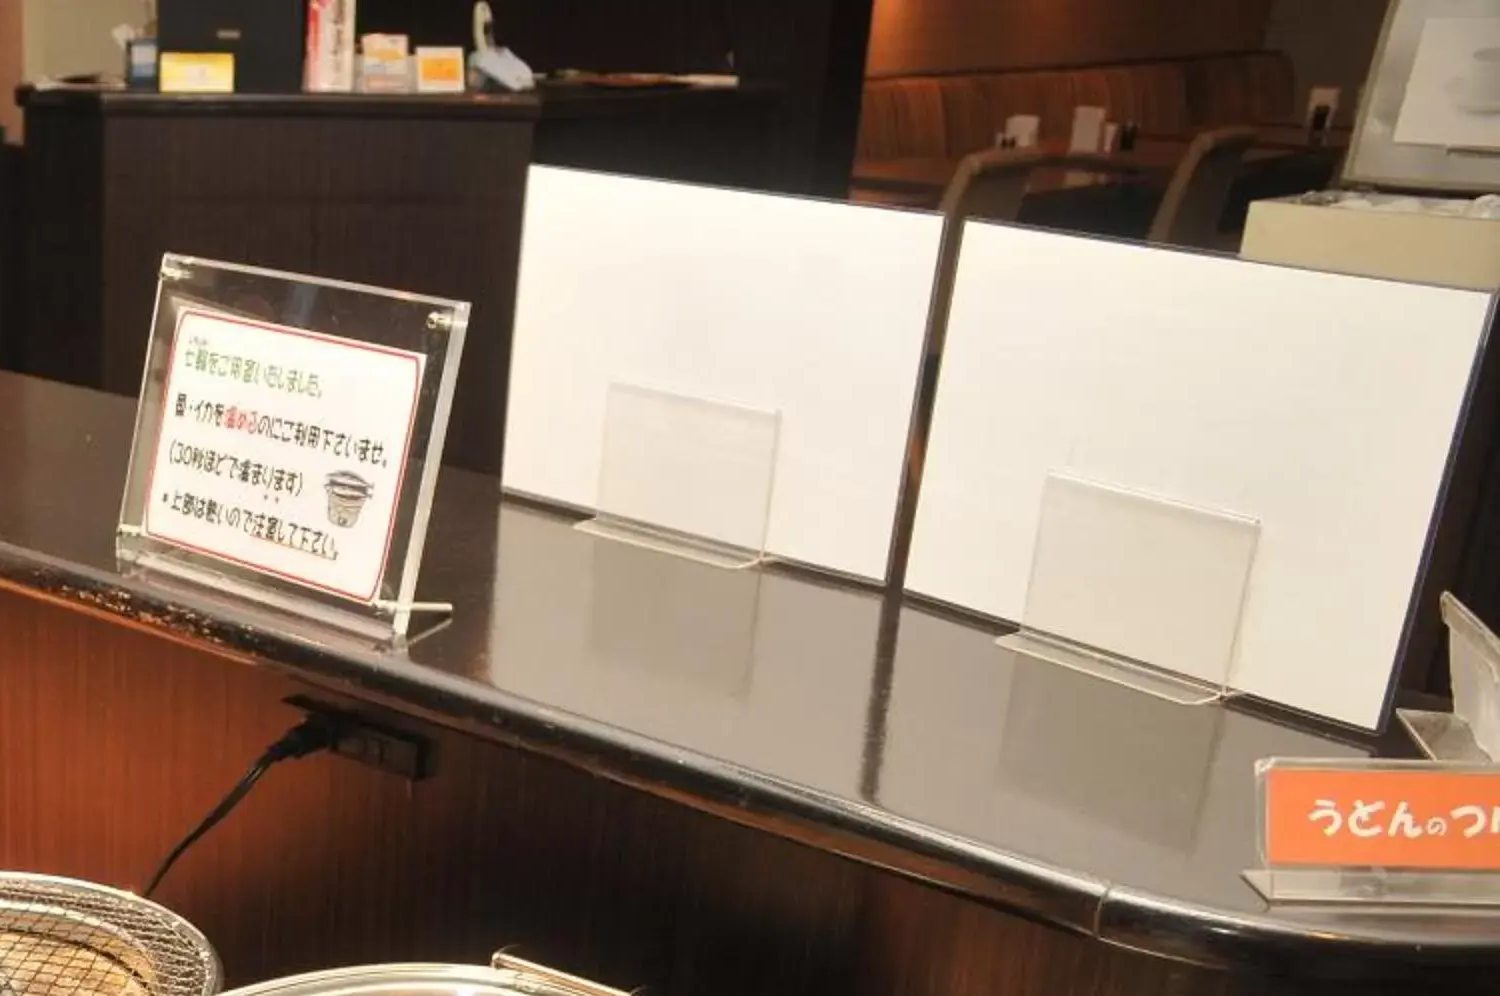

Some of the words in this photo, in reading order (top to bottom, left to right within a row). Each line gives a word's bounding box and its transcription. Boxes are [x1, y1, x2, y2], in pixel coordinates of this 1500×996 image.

[1307, 799, 1500, 839] うどんのつ
